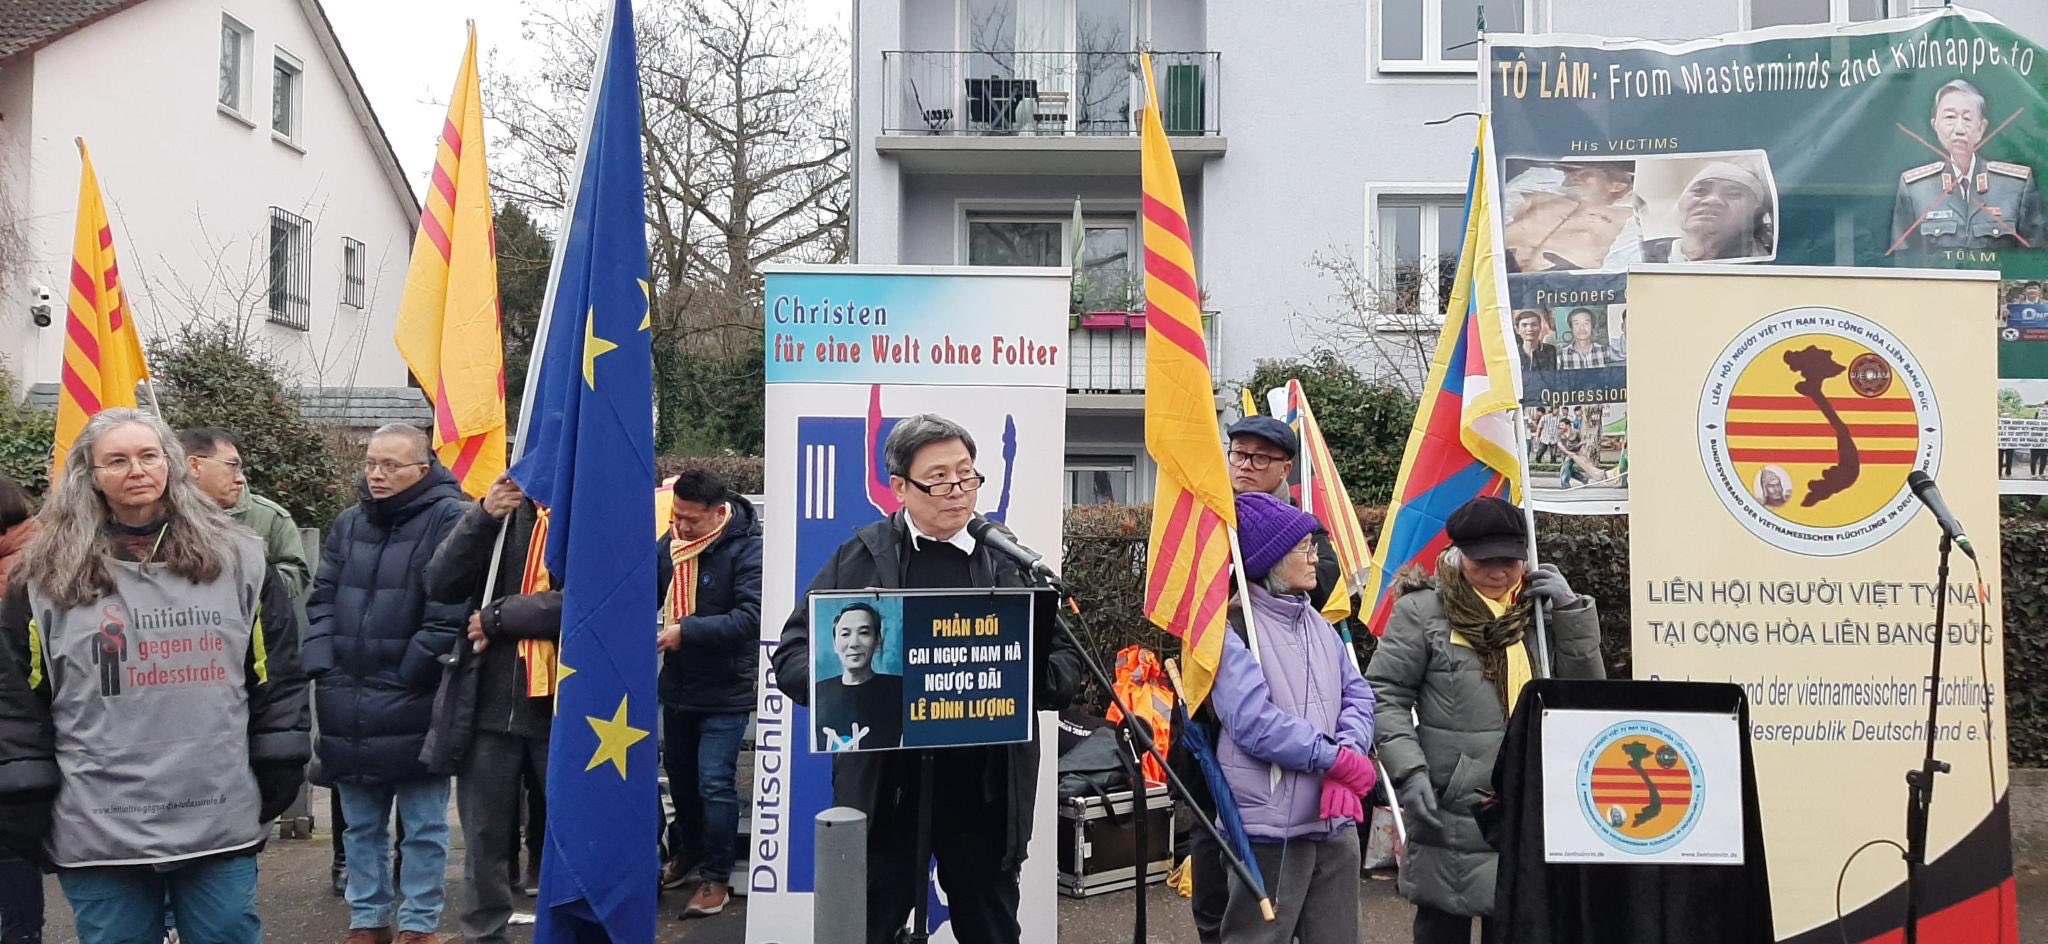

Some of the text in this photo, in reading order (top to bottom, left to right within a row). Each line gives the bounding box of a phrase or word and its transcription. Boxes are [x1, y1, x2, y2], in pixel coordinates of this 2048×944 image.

[1499, 52, 1528, 99] TÔ
[1540, 52, 1598, 99] LÂM:
[1609, 64, 1672, 99] From
[1681, 52, 1830, 94] Masterminds
[1839, 49, 1881, 88] and
[1571, 137, 1679, 151] His VICTIMS
[774, 295, 887, 326] Christen
[1536, 289, 1615, 304] Prisoners
[774, 333, 1058, 366] für eine Welt ohne Folter
[1541, 385, 1627, 407] Oppression
[1710, 439, 1744, 506] BUNDESVERBAND
[1743, 505, 1758, 520] DER
[1758, 516, 1834, 542] VIETNAMESISCHEN
[1836, 516, 1888, 541] FLÜCHTLINGE
[1888, 511, 1898, 520] IN
[1647, 576, 1704, 604] LIÊN
[1711, 579, 1752, 608] HỘI
[1760, 577, 1843, 605] NGƯỜI
[1850, 580, 1903, 609] VIỆT
[133, 605, 222, 630] Initiative
[932, 612, 999, 638] PHẢN ĐỐI
[1647, 620, 1687, 648] TẠI
[1693, 619, 1759, 648] CỘNG
[1765, 617, 1816, 645] HÒA
[1821, 618, 1871, 646] LIÊN
[138, 630, 223, 661] gegen die
[908, 640, 1022, 667] CAI NGỤC NAM HÀ
[127, 658, 226, 688] Todesstrafe
[924, 667, 1002, 695] NGƯỢC ĐÃI
[910, 697, 1015, 721] LÊ ĐÌNH LƯỢNG
[1768, 675, 1793, 706] der
[1796, 675, 1917, 706] vietnamesischen
[1922, 675, 1995, 713] Füchtlinge
